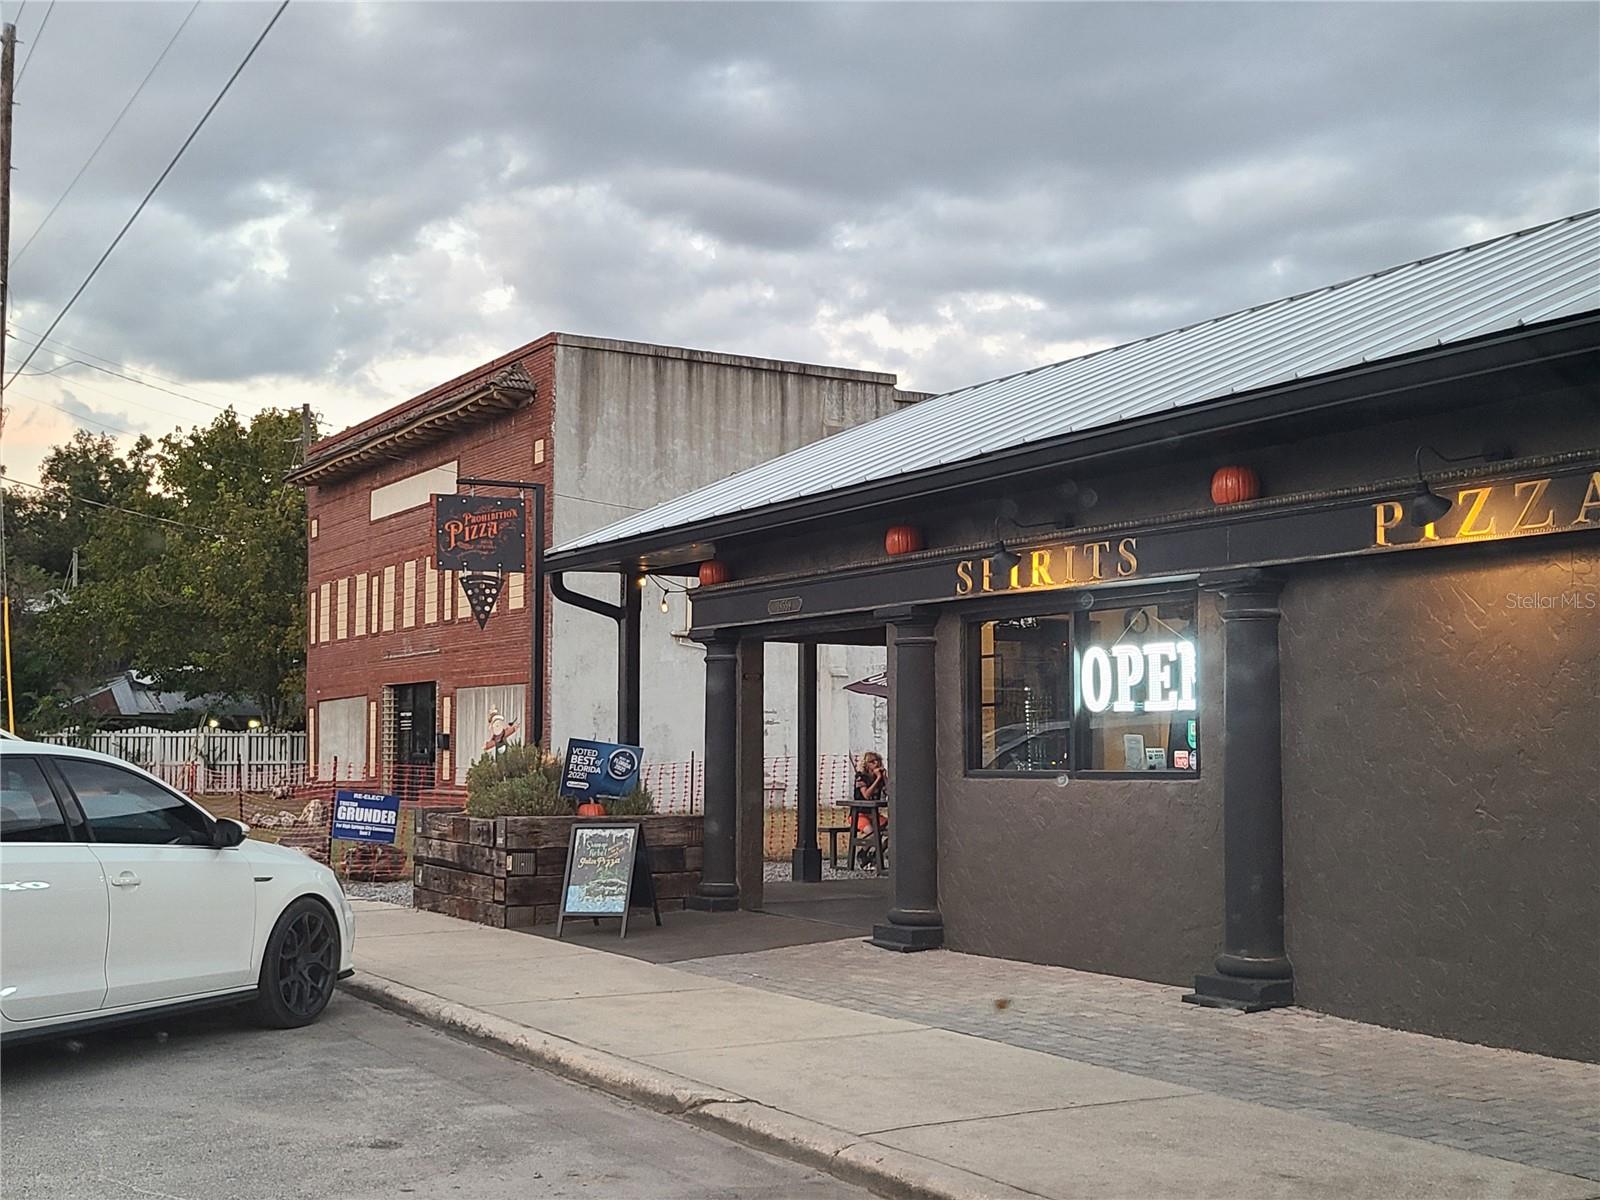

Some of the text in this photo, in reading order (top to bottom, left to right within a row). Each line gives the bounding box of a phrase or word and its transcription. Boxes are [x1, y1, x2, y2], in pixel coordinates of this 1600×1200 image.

[463, 508, 518, 524] PROHIBITION
[444, 520, 498, 551] PIZZA
[572, 747, 598, 757] VOTED
[570, 755, 604, 767] BEST of
[568, 764, 601, 774] FLORIDA
[353, 793, 385, 801] RE-ELECT
[337, 806, 397, 825] GRUNDER
